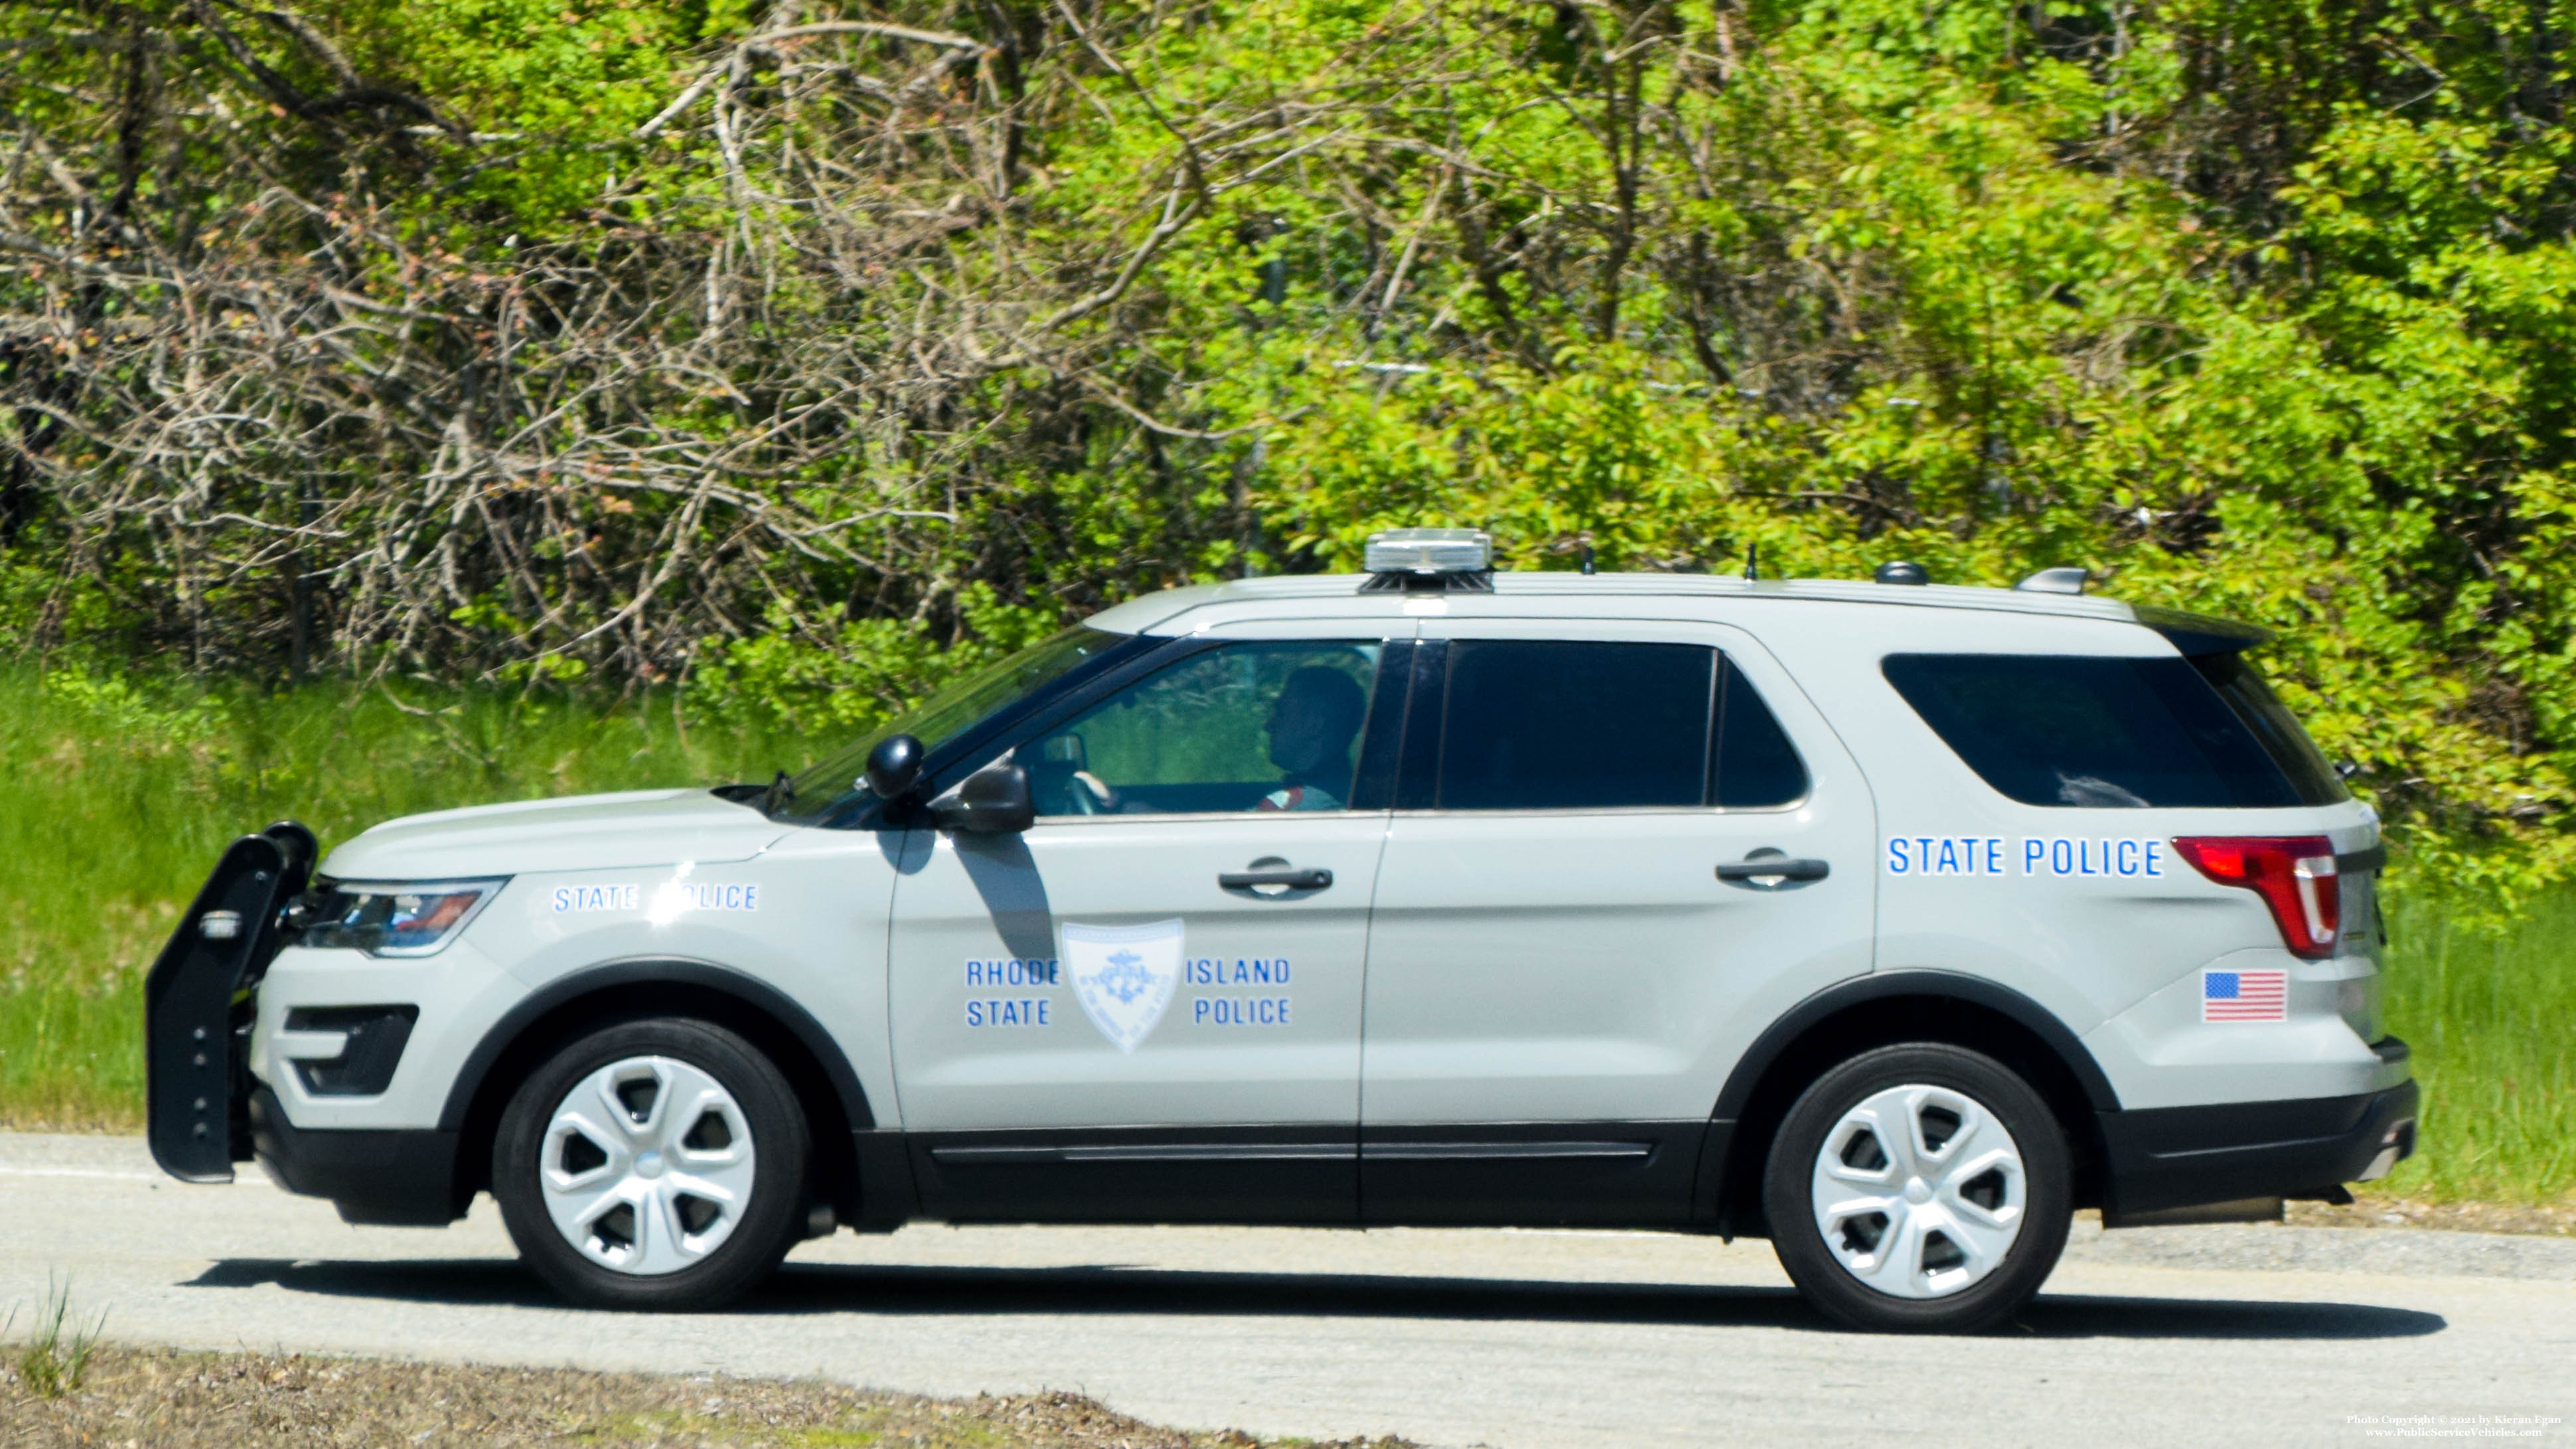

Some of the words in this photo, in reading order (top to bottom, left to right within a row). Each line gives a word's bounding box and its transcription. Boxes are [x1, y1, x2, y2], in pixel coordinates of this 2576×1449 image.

[1889, 837, 2003, 874] STATE
[2024, 839, 2162, 876] POLICE
[554, 885, 637, 912] STATE
[663, 884, 757, 910] LICE
[966, 959, 1059, 986] RHODE
[1186, 958, 1290, 984] ISLAND
[966, 1000, 1049, 1026] STATE
[1195, 998, 1290, 1024] POLICE
